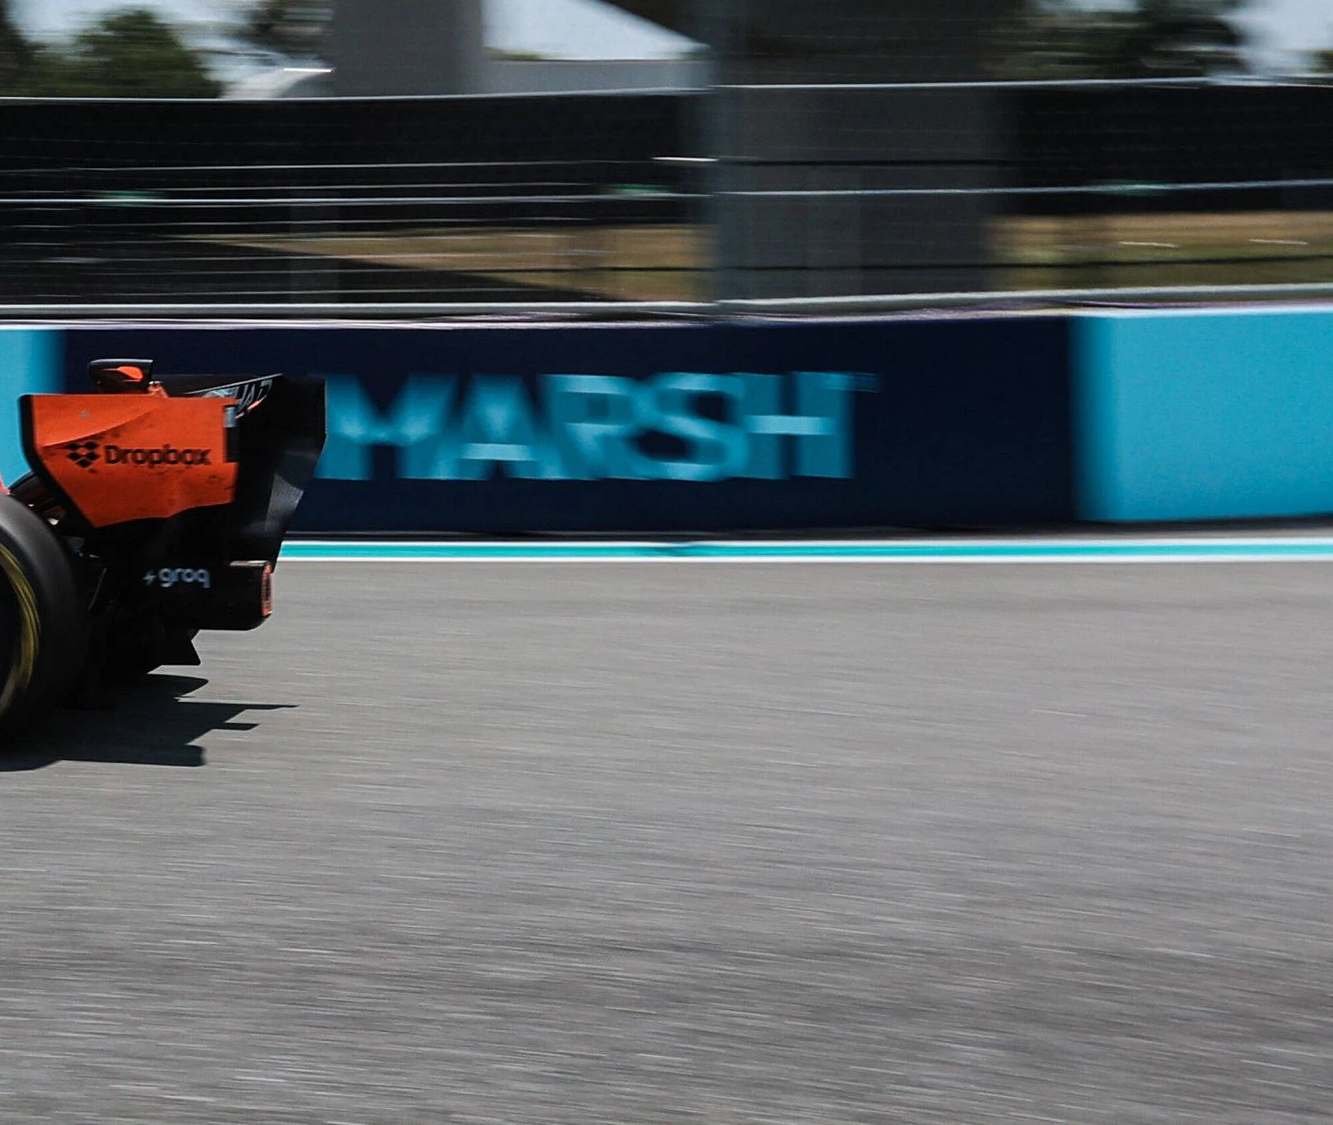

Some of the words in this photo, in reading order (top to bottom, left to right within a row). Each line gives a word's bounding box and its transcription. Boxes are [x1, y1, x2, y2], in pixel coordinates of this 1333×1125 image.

[323, 371, 853, 479] MARSH
[104, 444, 213, 470] Dropbox
[158, 568, 211, 589] groq
